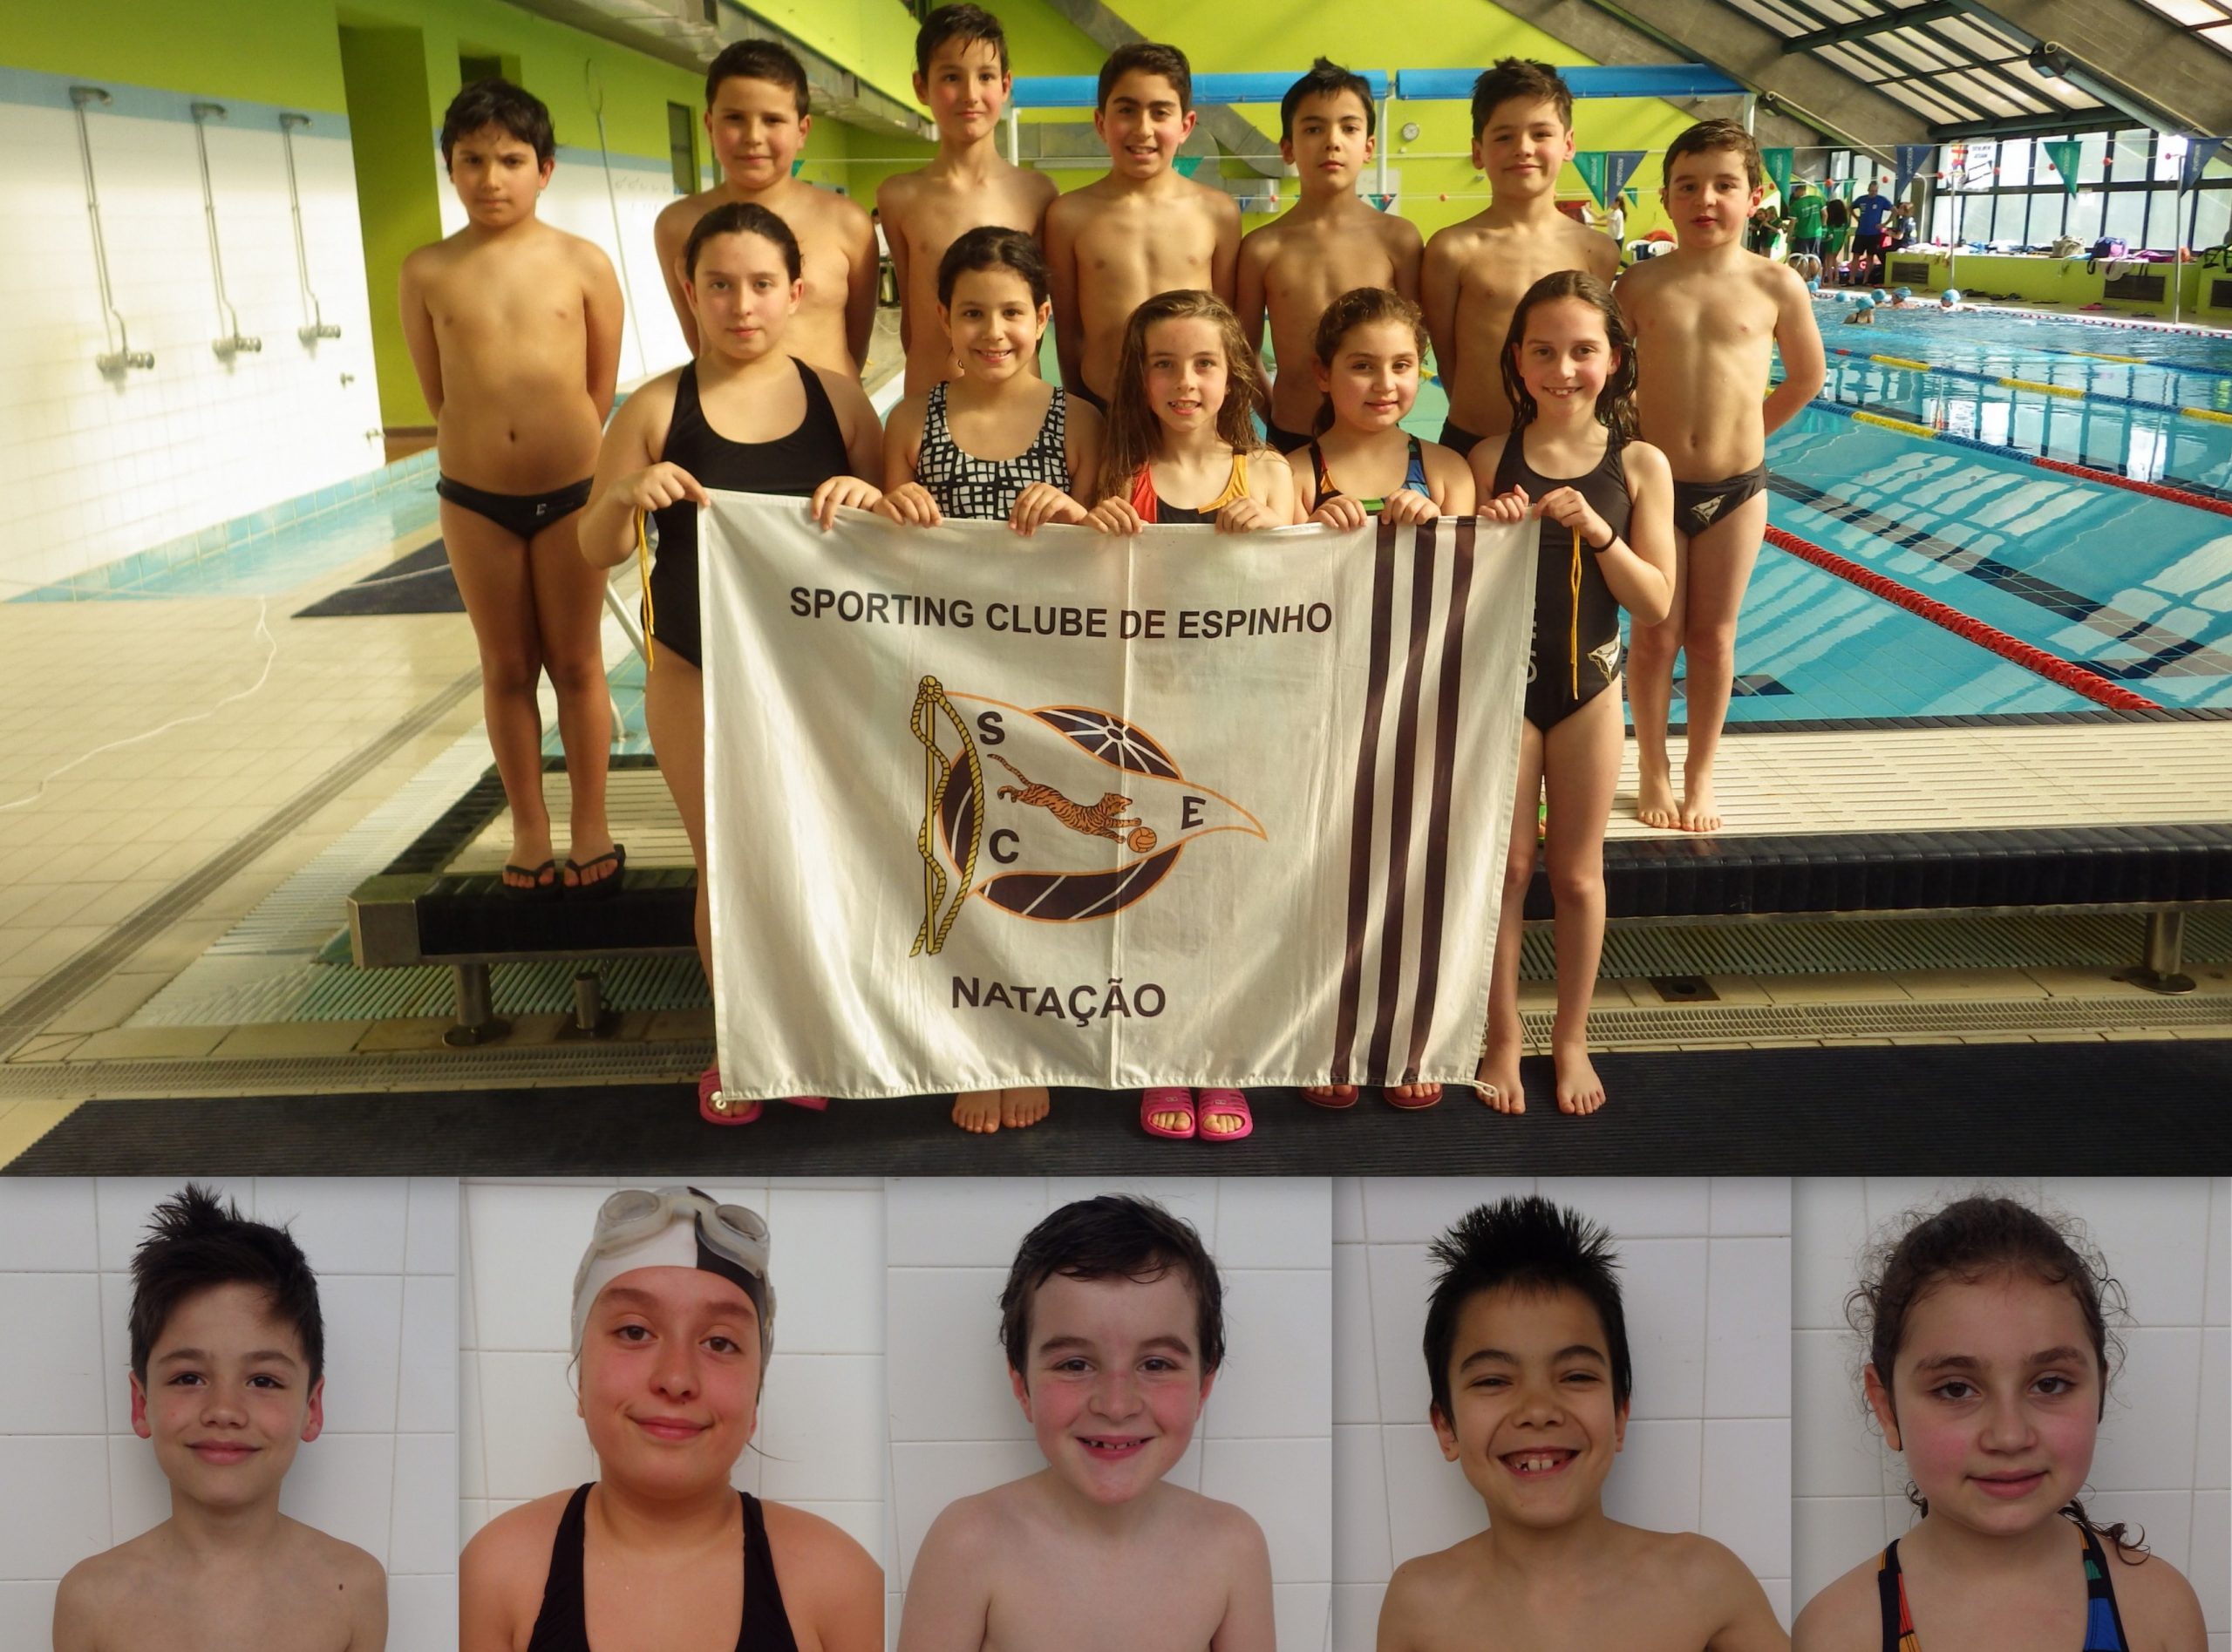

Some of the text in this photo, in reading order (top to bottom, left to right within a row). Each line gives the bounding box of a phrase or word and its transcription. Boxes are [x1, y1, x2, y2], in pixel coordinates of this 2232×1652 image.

[790, 586, 1332, 640] SPORTING CLUBE DE ESPINHO
[977, 710, 1005, 746] S
[1181, 795, 1207, 830] E
[988, 828, 1020, 865] C
[952, 976, 1166, 1028] NATAÇÃO
